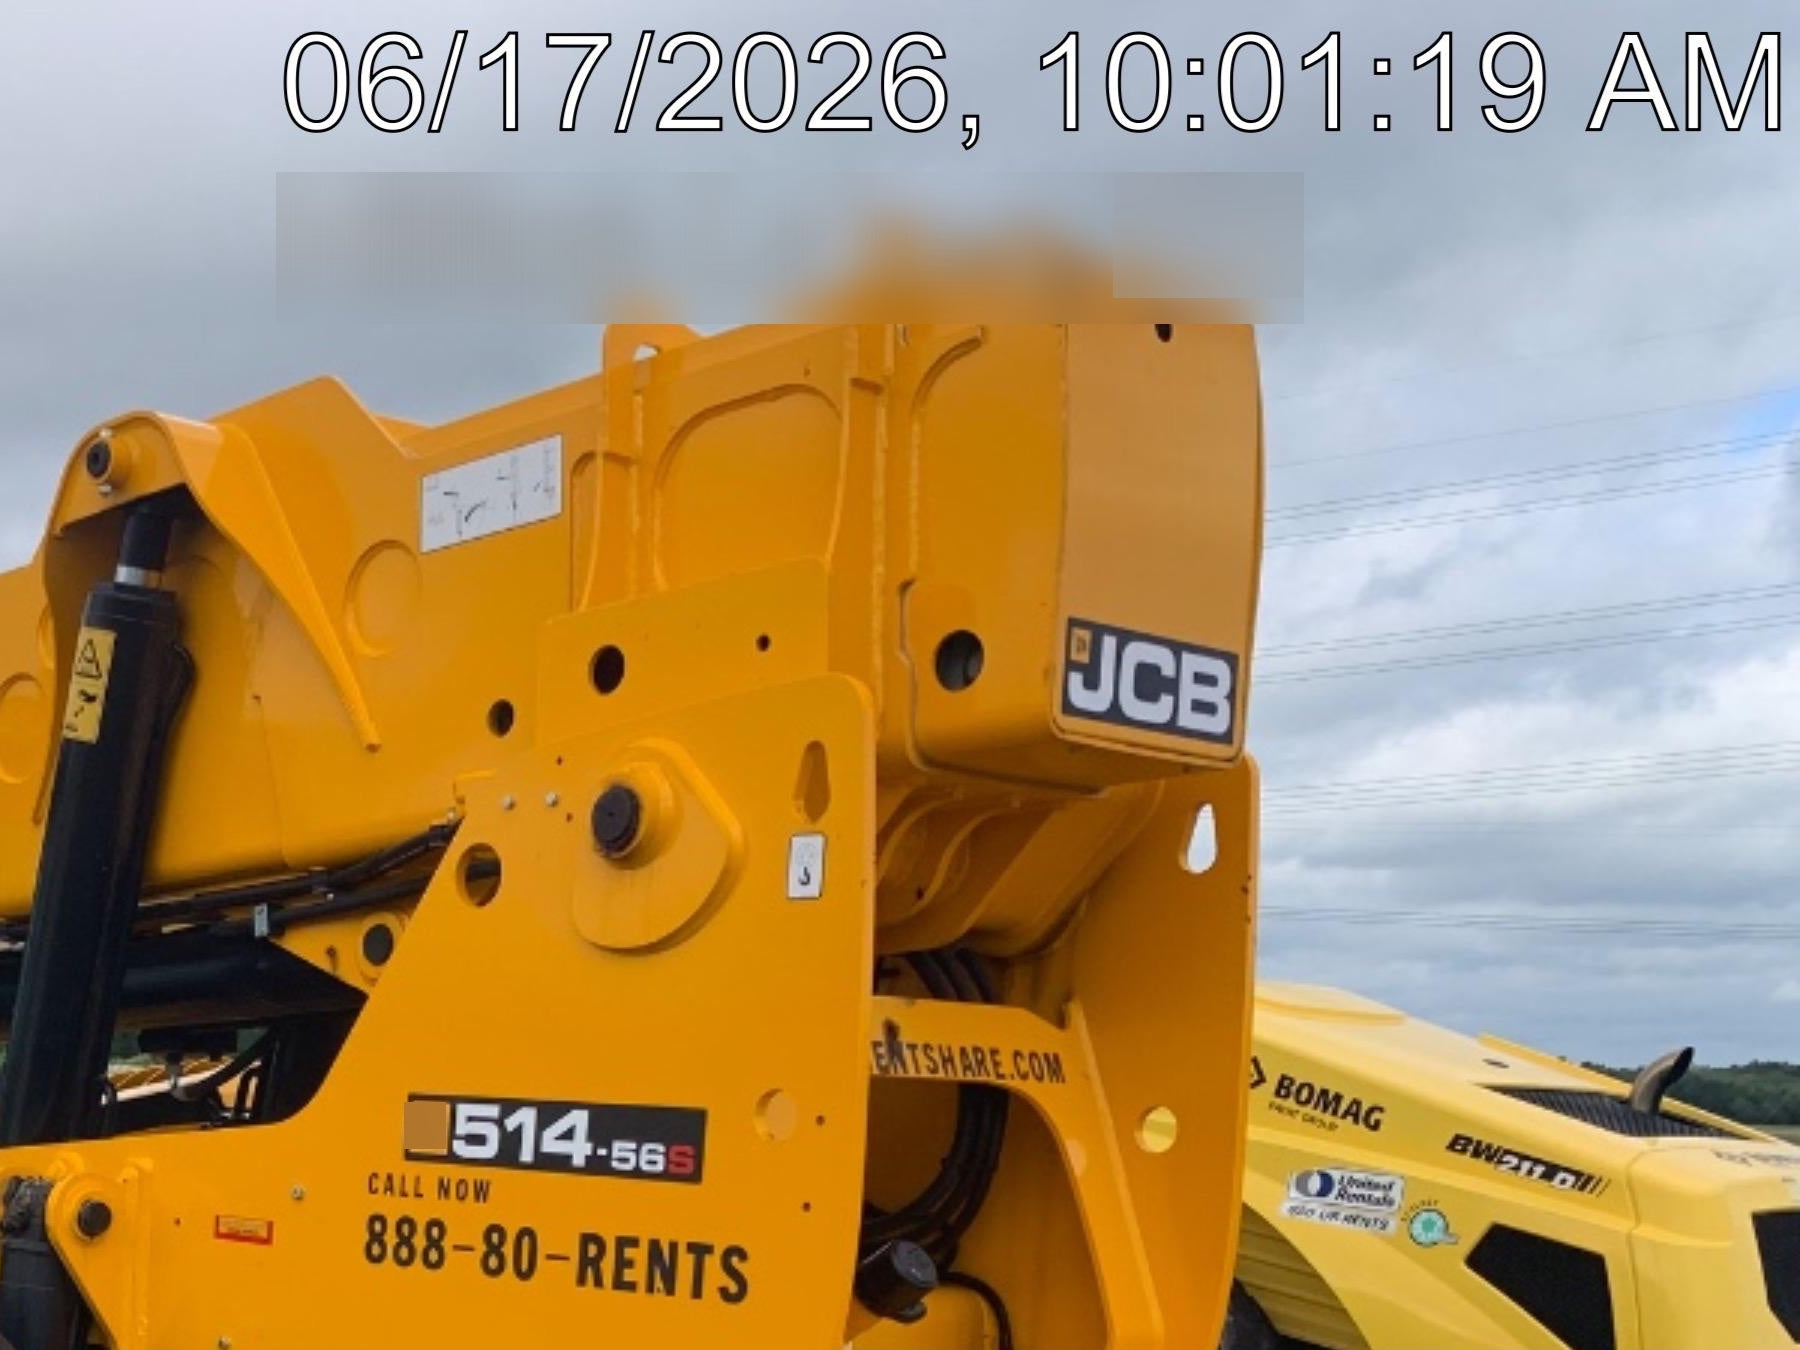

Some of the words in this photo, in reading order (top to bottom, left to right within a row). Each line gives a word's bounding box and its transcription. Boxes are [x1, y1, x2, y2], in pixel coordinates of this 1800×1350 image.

[1068, 633, 1232, 736] JCB
[1274, 1072, 1385, 1132] BOMAG
[367, 1171, 425, 1198] CALL
[437, 1174, 492, 1204] NOW
[364, 1212, 750, 1305] 888-80-RENTS
